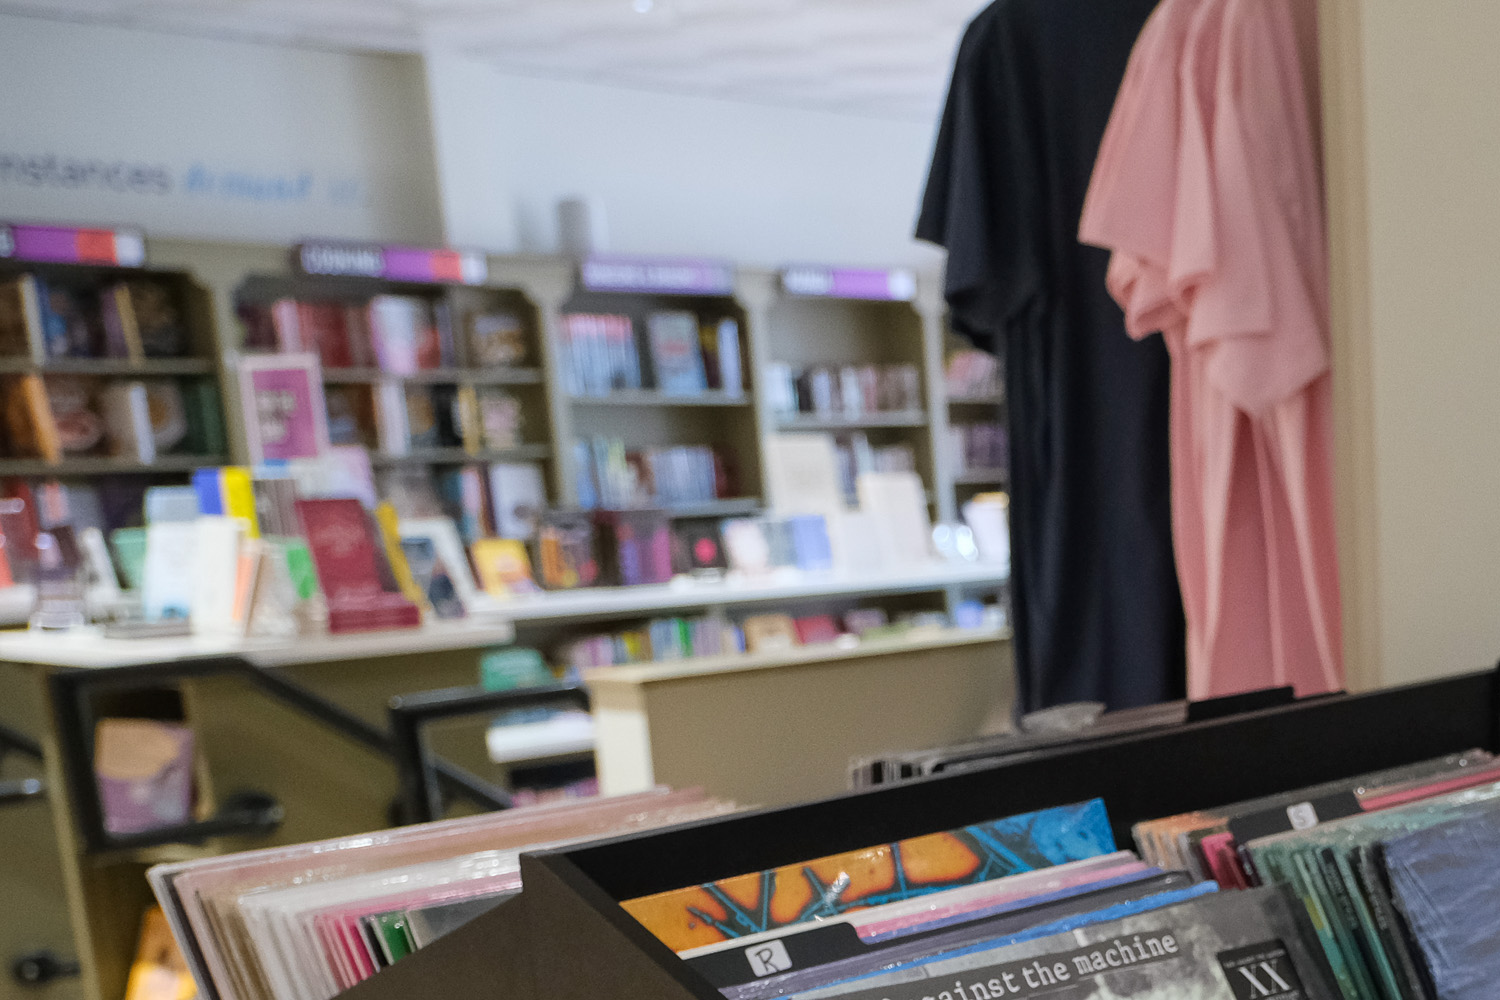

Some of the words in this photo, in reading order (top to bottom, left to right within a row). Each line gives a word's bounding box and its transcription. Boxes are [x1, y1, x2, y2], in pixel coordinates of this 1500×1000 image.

[754, 949, 780, 974] R
[1021, 961, 1071, 990] the
[1073, 931, 1181, 976] machine
[1239, 958, 1291, 999] XX
